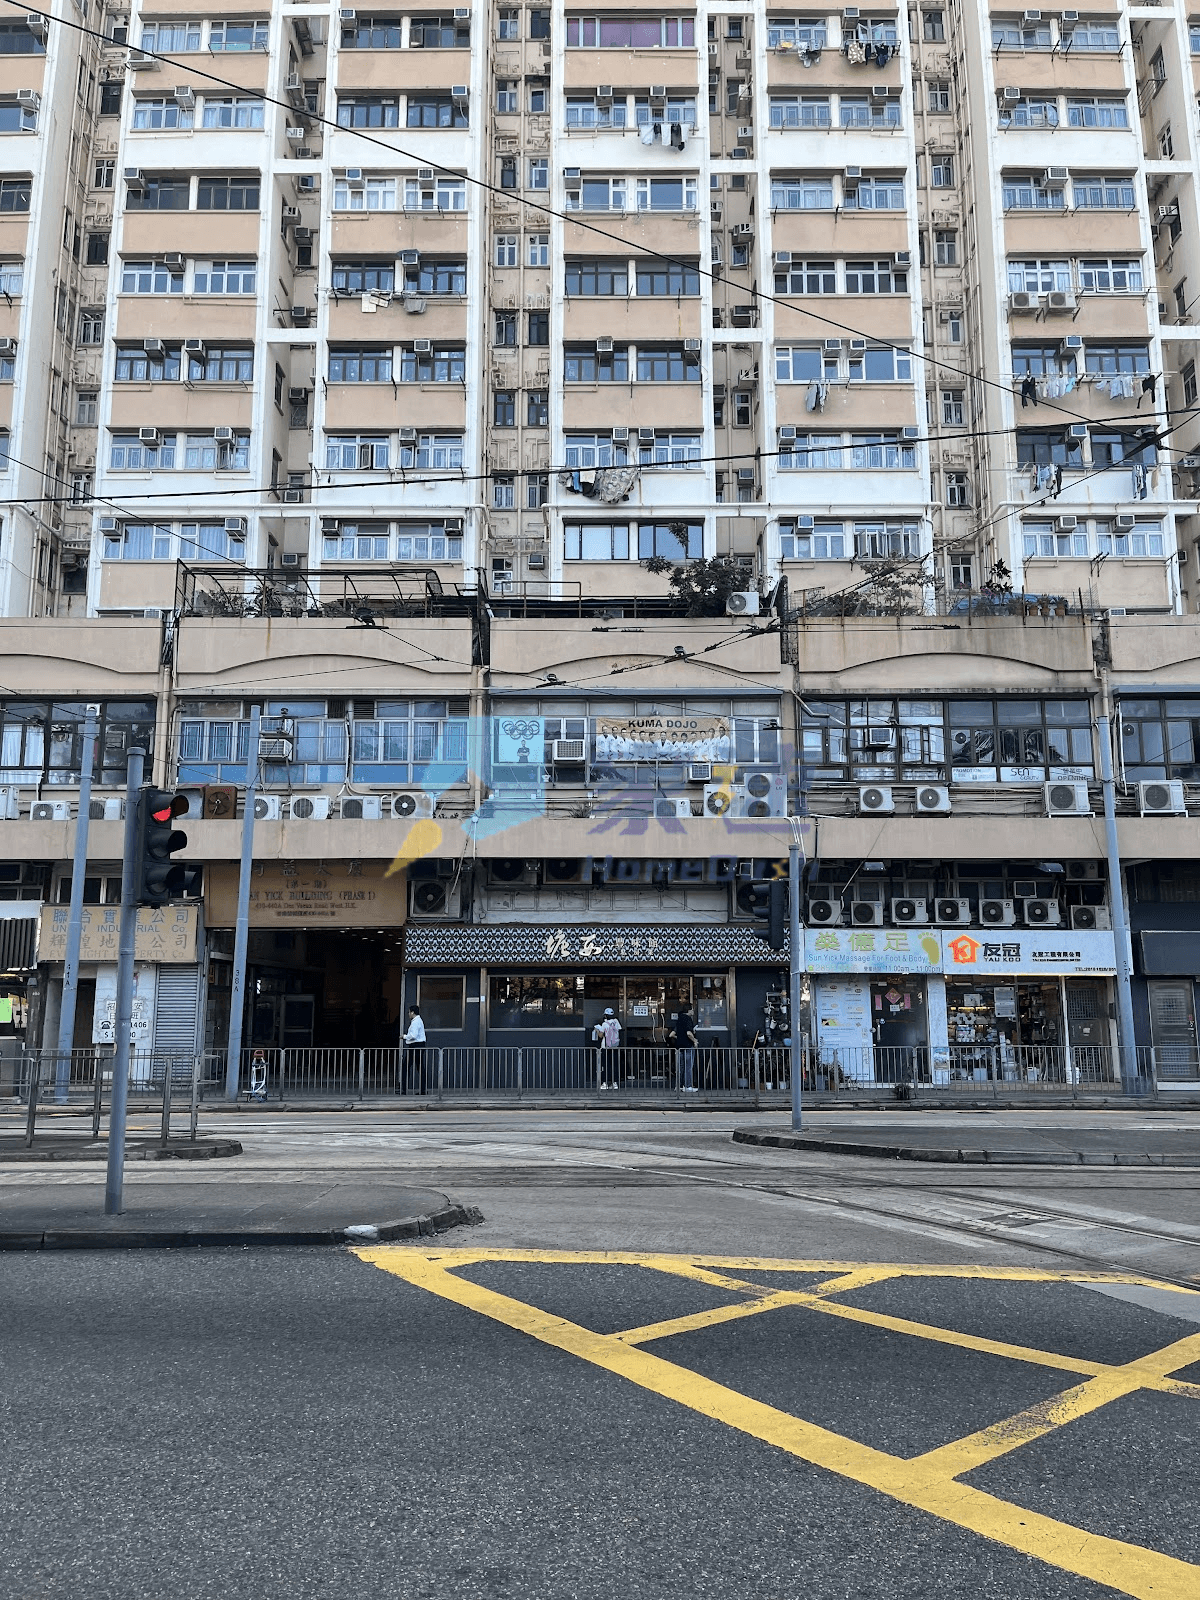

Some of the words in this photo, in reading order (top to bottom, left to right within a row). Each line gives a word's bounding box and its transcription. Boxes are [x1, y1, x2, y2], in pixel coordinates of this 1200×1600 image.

[628, 719, 663, 728] KUMA
[666, 720, 698, 729] DOJO
[264, 891, 283, 900] YICK
[289, 891, 333, 900] BUILDING
[52, 924, 86, 932] UNN
[97, 924, 160, 932] INDURIAL
[50, 933, 188, 949] 輝煌地公司
[983, 943, 1021, 957] 友冠
[839, 953, 870, 964] Massage
[872, 953, 884, 961] For
[885, 953, 901, 961] Foot
[908, 953, 926, 963] Body
[110, 1021, 147, 1029] 21406
